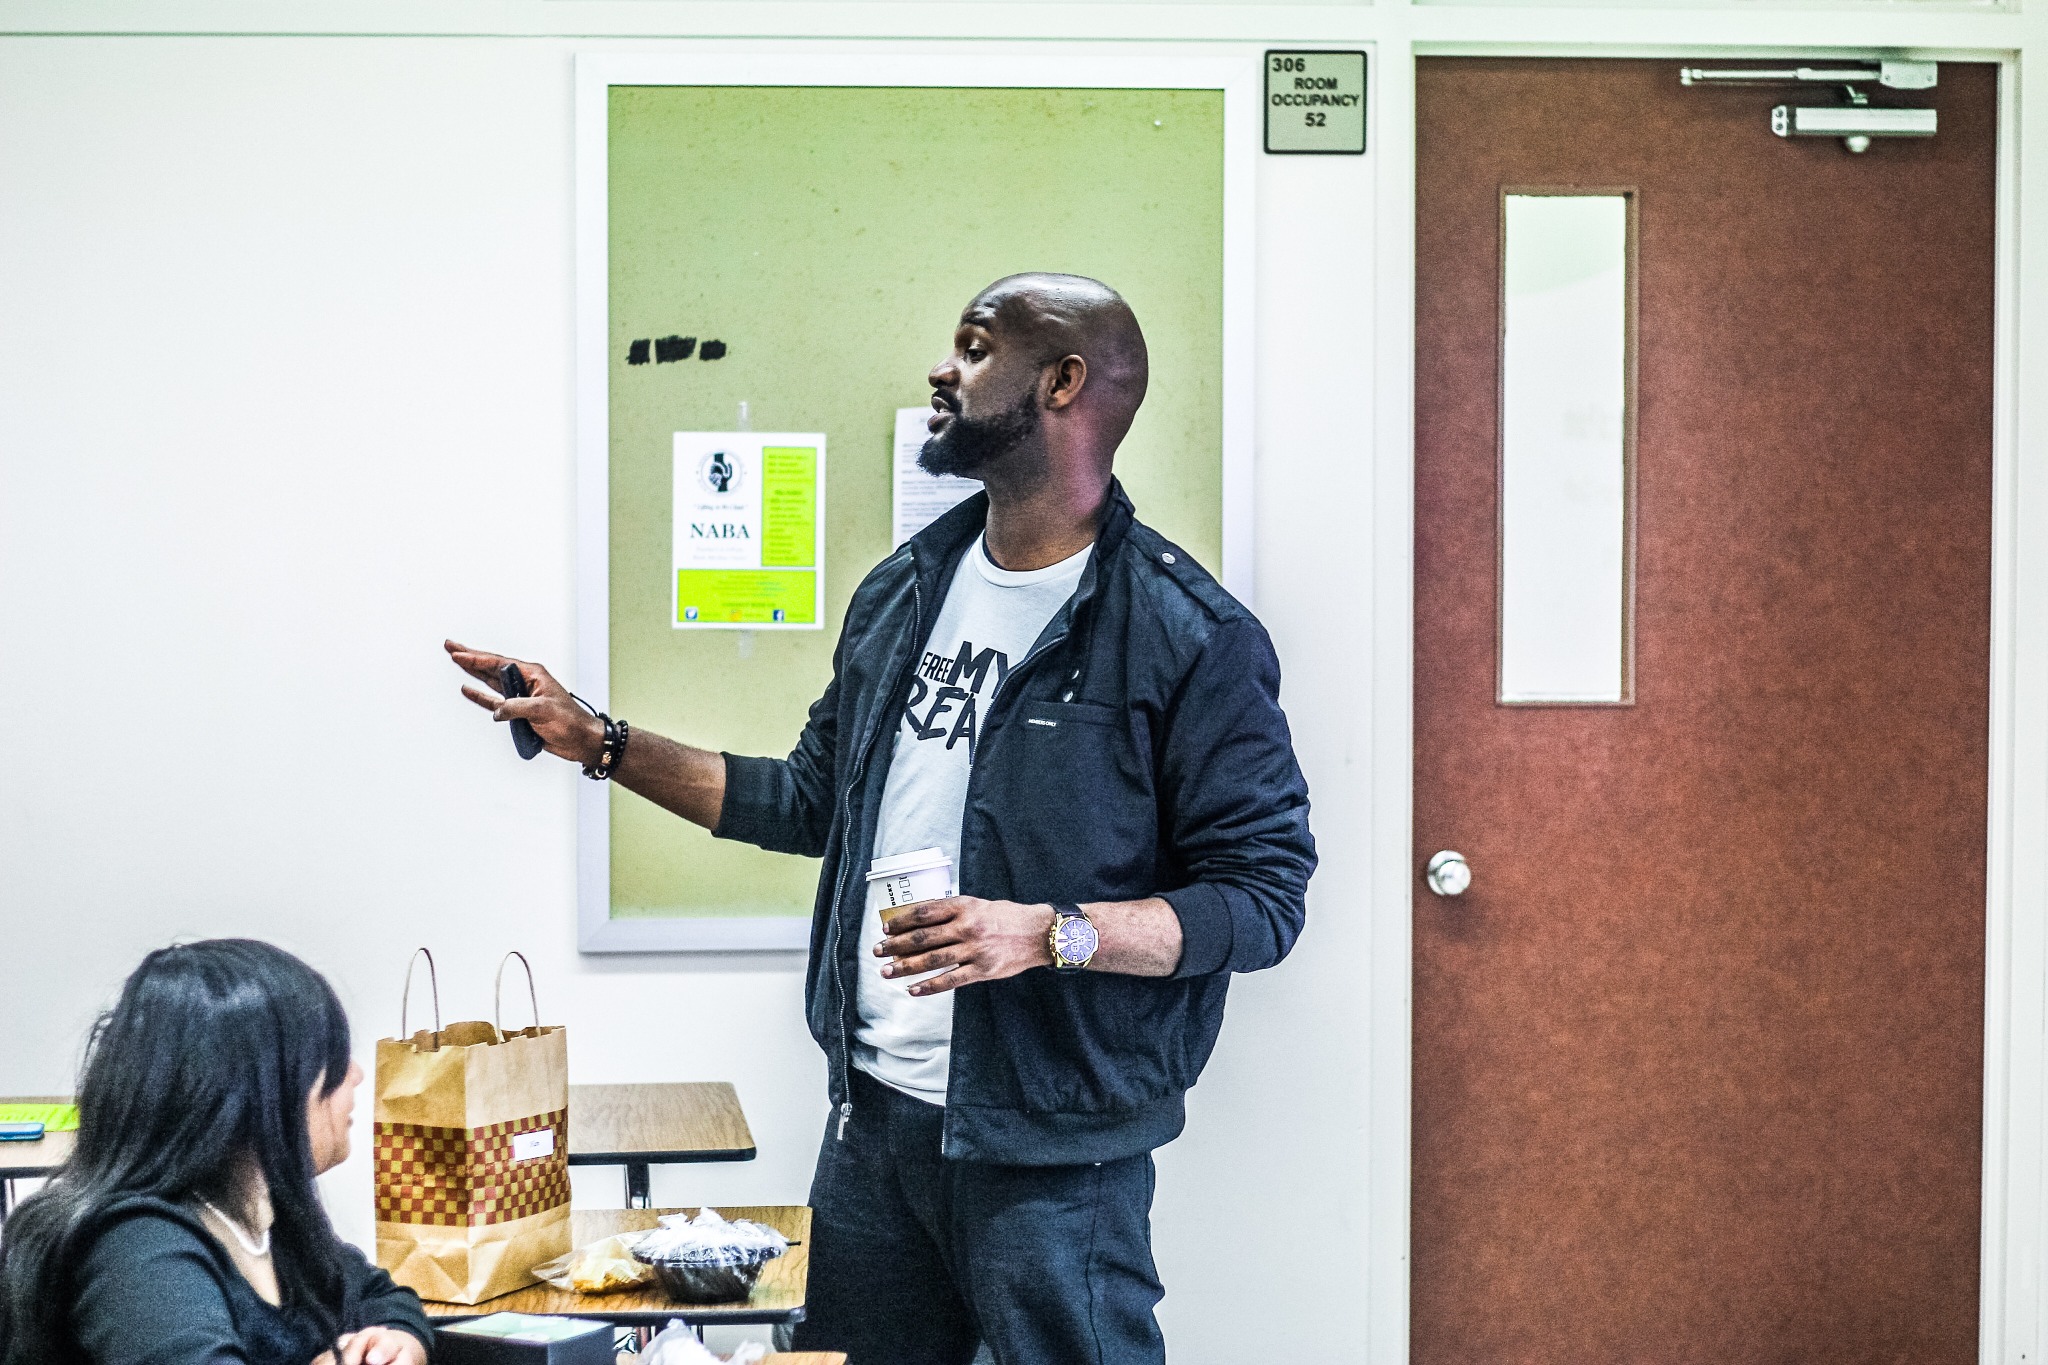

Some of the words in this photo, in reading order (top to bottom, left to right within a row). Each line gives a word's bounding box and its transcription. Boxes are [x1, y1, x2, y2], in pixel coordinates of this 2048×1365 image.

[1272, 58, 1305, 72] 306
[1294, 77, 1338, 90] ROOM
[1271, 94, 1359, 106] OCCUPANCY
[1305, 112, 1326, 127] 52
[690, 523, 750, 538] NABA
[918, 652, 954, 683] FREE
